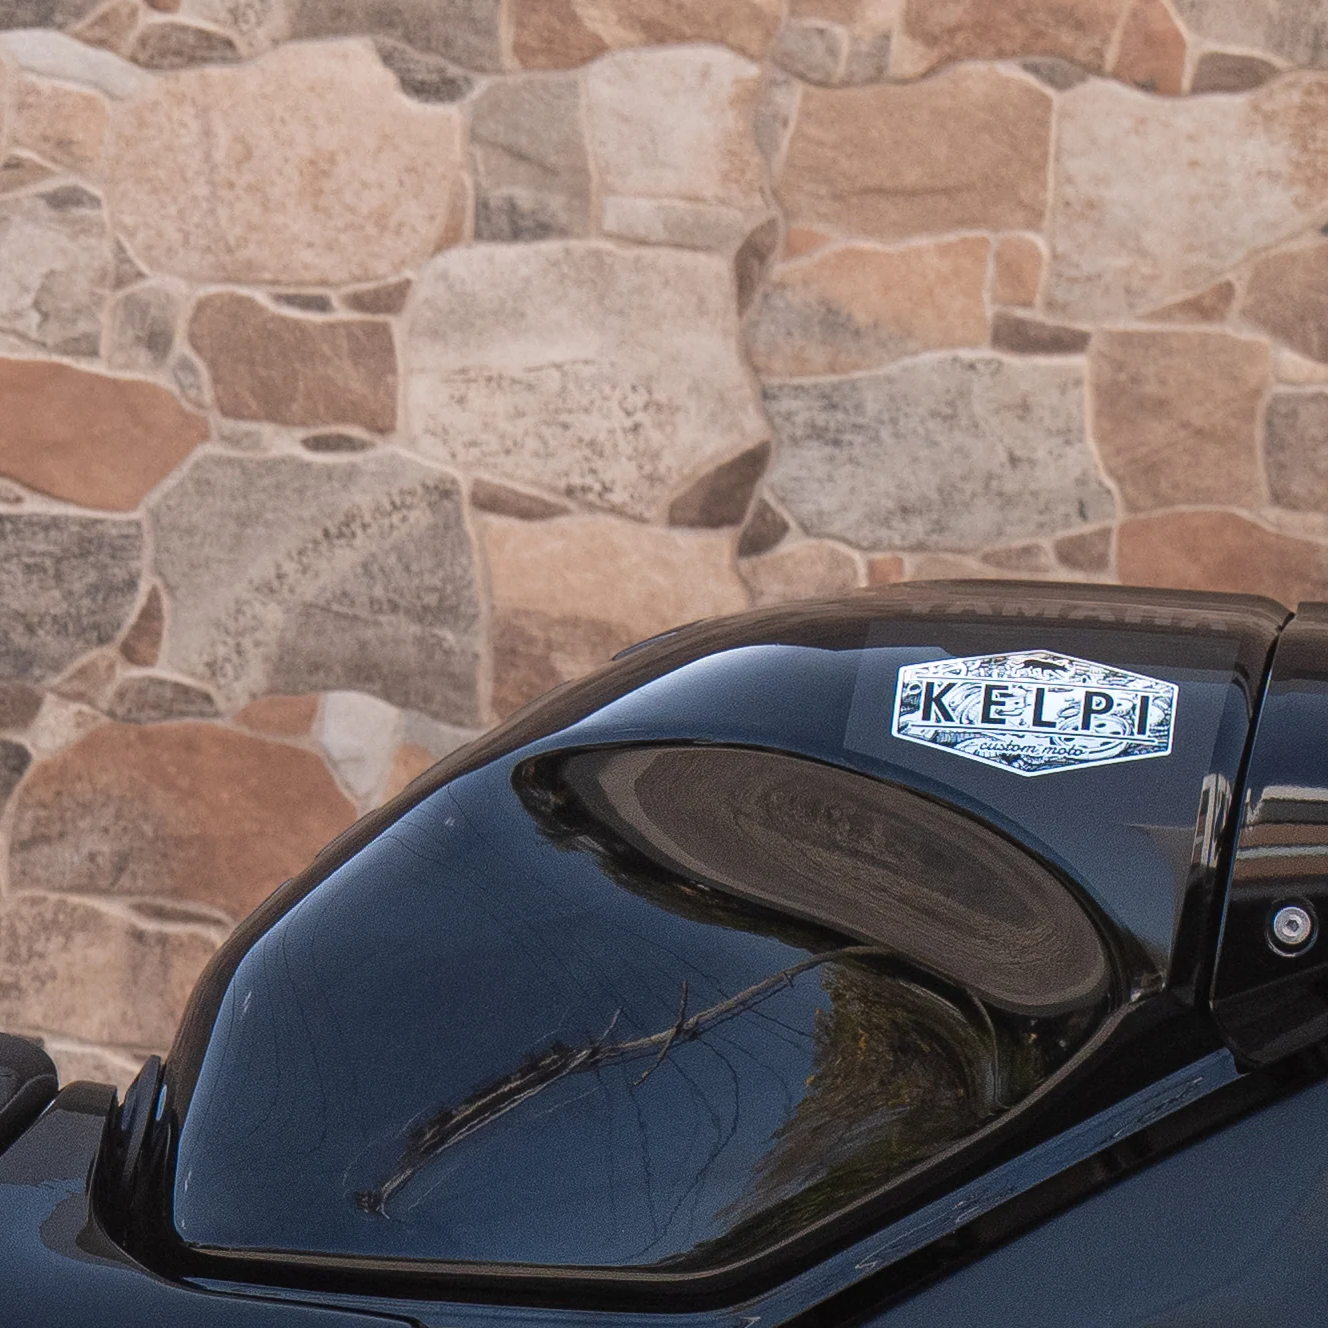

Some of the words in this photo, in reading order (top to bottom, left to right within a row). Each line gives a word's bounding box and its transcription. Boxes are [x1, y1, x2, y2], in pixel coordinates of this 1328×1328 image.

[920, 680, 1152, 737] KELPI
[979, 739, 1036, 753] custom
[1041, 744, 1085, 757] moto
